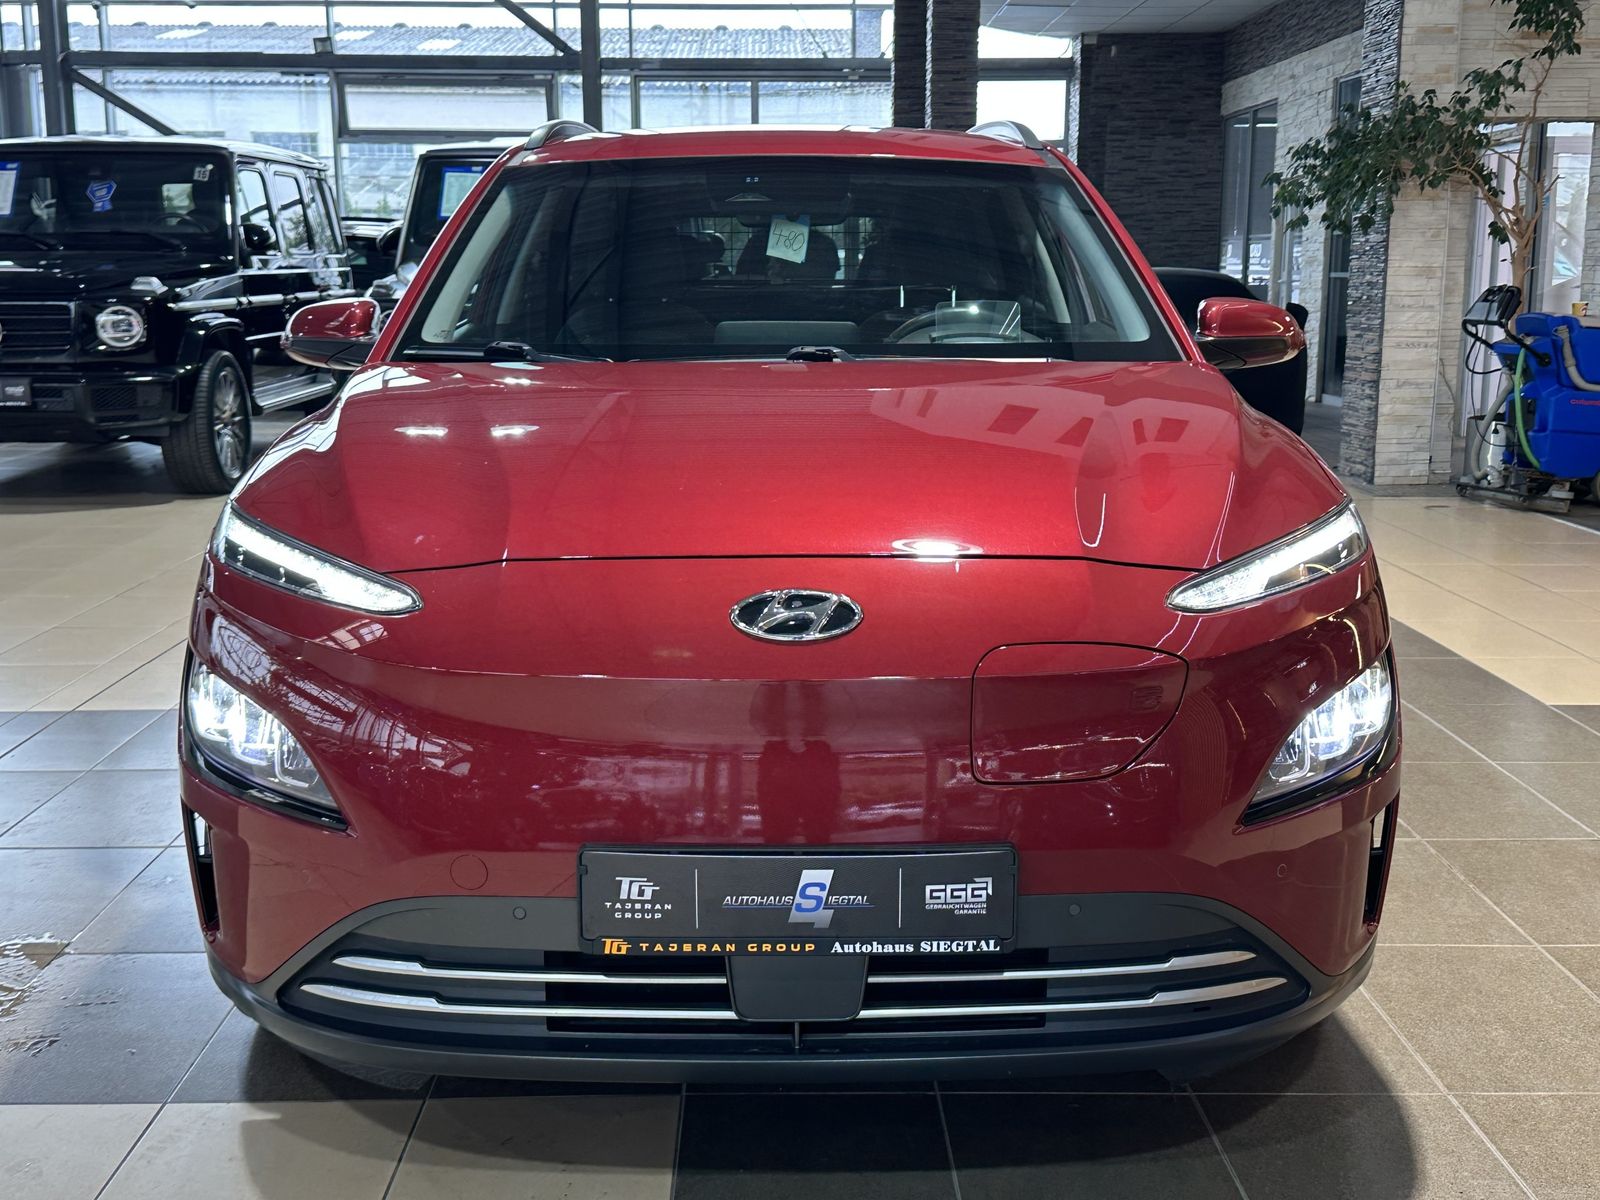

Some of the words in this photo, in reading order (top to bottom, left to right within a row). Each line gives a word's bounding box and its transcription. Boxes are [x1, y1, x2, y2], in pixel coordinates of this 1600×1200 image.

[772, 223, 806, 252] 480
[925, 882, 987, 903] GGG
[722, 895, 794, 906] AUTOHAUS
[640, 943, 736, 952] TAJERAN
[747, 943, 816, 952] GROUP
[831, 941, 914, 953] Autohaus
[920, 939, 1000, 953] SIEGTAL
